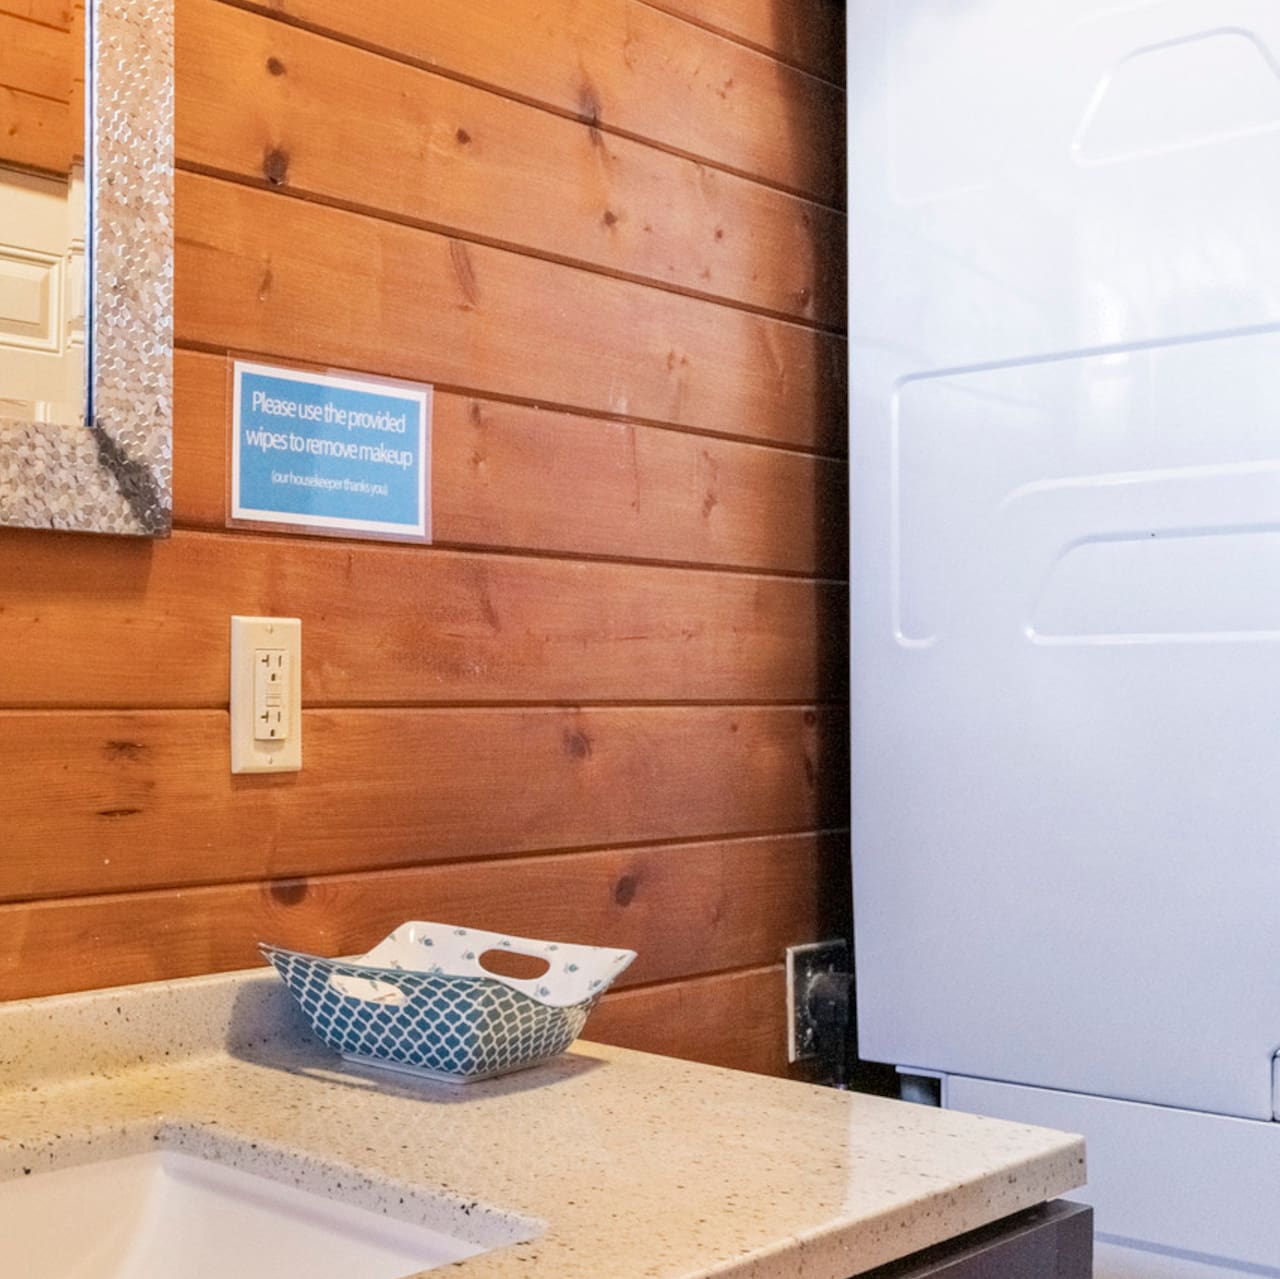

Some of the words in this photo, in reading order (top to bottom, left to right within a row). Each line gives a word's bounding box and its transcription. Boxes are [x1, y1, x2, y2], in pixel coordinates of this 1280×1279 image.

[252, 390, 297, 418] Please
[298, 403, 323, 422] use
[324, 401, 347, 425] the
[347, 409, 407, 433] provided
[245, 426, 289, 453] wipes
[289, 432, 305, 452] to
[305, 437, 358, 460] remove
[359, 441, 414, 471] makeup
